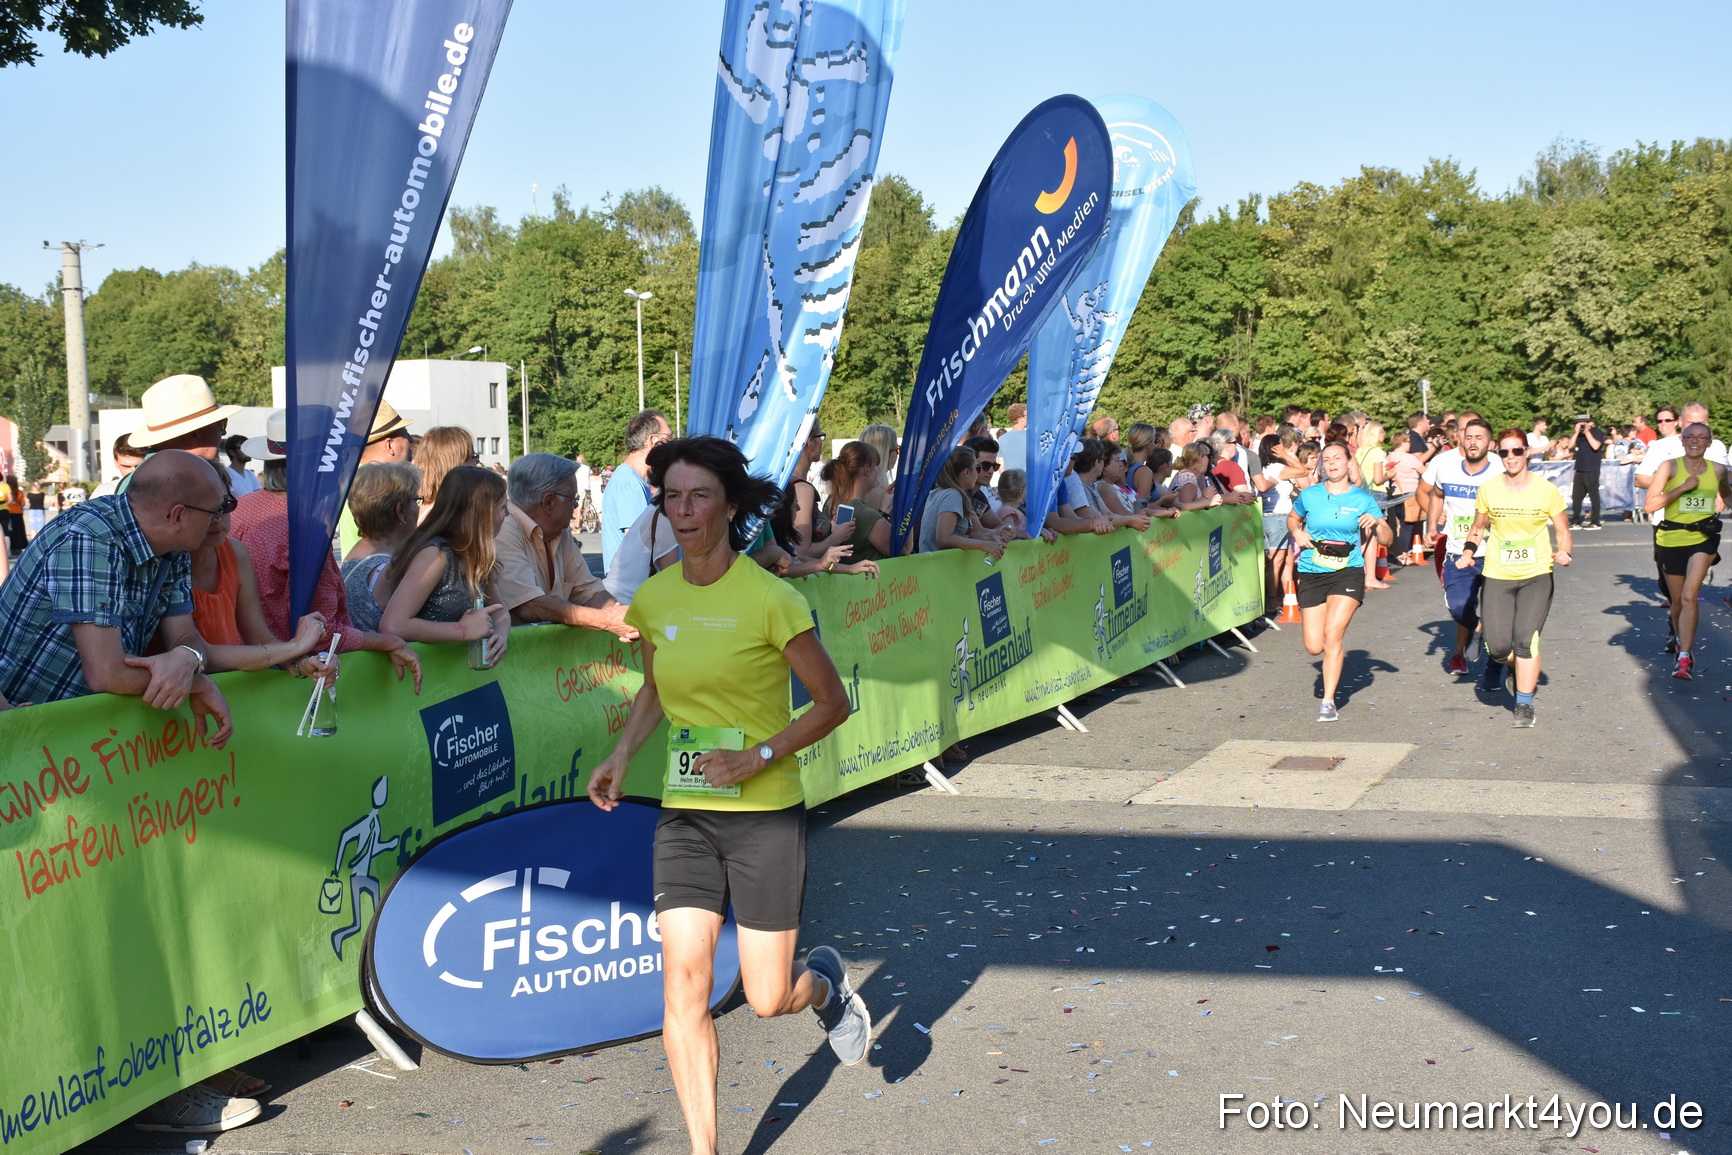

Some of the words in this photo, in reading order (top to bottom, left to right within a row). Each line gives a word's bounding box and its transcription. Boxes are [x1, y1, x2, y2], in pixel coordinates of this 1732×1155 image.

[317, 22, 475, 473] www.fischer-automobile.de
[1002, 283, 1036, 331] Druck
[1034, 252, 1057, 285] und
[1056, 191, 1099, 253] Medien
[925, 225, 1051, 418] Frischmann
[1685, 497, 1705, 507] 331
[1506, 548, 1529, 560] 738
[845, 582, 888, 629] Gesunde
[888, 575, 921, 606] Firmen
[868, 617, 899, 656] laufen
[898, 594, 934, 641] länger!
[983, 595, 1002, 613] Fischer
[1107, 582, 1149, 640] firmenlauf
[556, 638, 627, 703] Gesunde
[973, 615, 1033, 687] firmenlauf
[602, 685, 638, 736] lauf
[977, 675, 1007, 704] neumarkt
[446, 723, 499, 760] Fischer
[453, 742, 499, 770] AUTOMOBILE
[678, 751, 703, 776] 92
[0, 745, 91, 824] unde
[90, 718, 208, 785] Firmen
[16, 815, 125, 899] laufen
[127, 752, 241, 845] länger!
[482, 900, 663, 972] Fische
[510, 952, 663, 998] AUTOMOBI
[0, 982, 272, 1145] menlauf-oberpfalz.de
